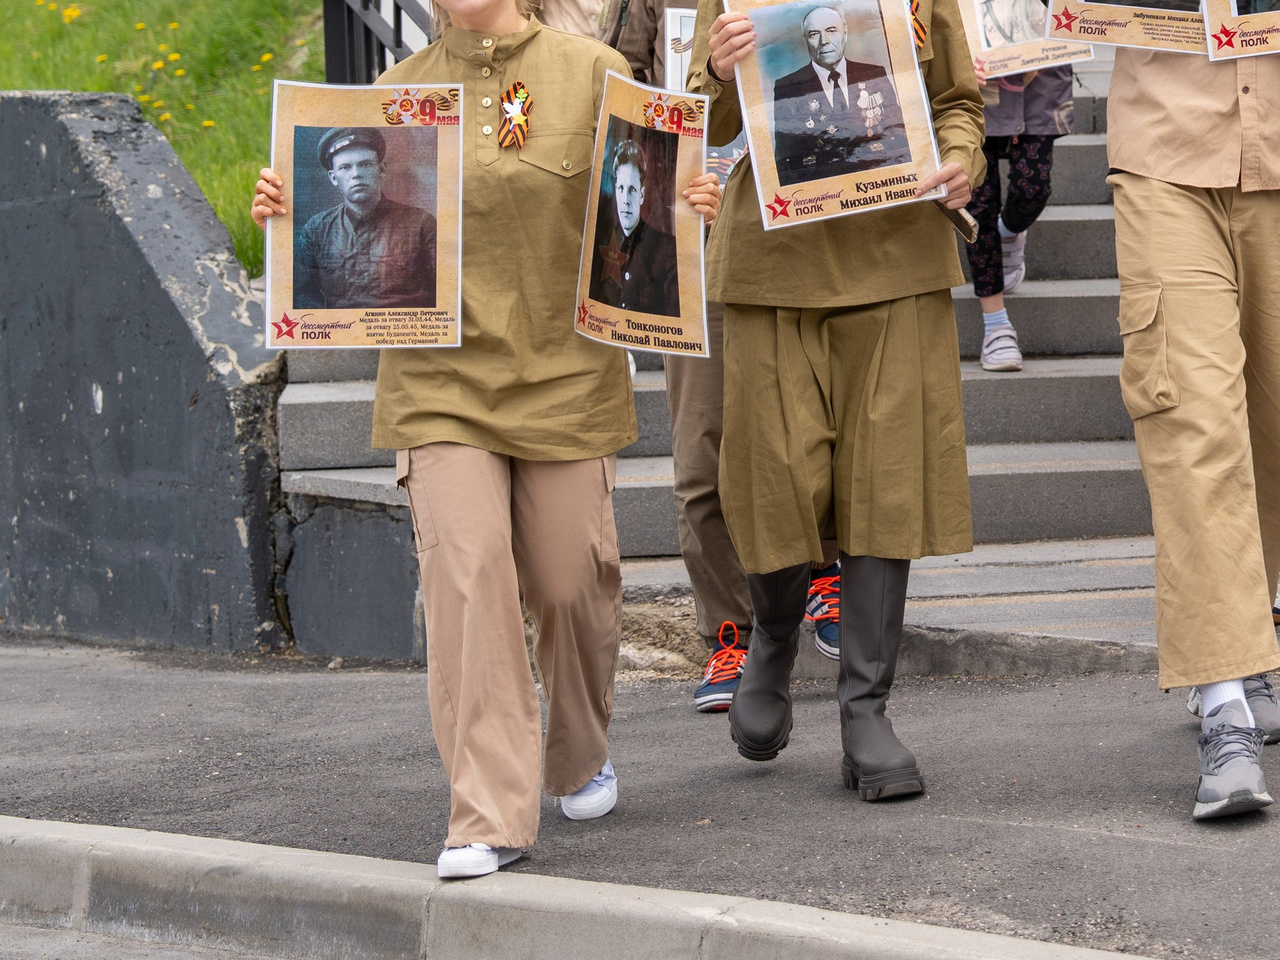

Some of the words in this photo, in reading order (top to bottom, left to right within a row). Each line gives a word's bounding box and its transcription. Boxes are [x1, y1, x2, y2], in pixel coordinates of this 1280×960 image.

[419, 98, 437, 126] 9
[668, 106, 683, 133] 9
[855, 173, 918, 193] Кузьминых
[840, 193, 883, 211] Михаил
[625, 319, 683, 336] Тонконогов
[611, 330, 651, 345] Николай
[653, 337, 702, 351] Павлович
